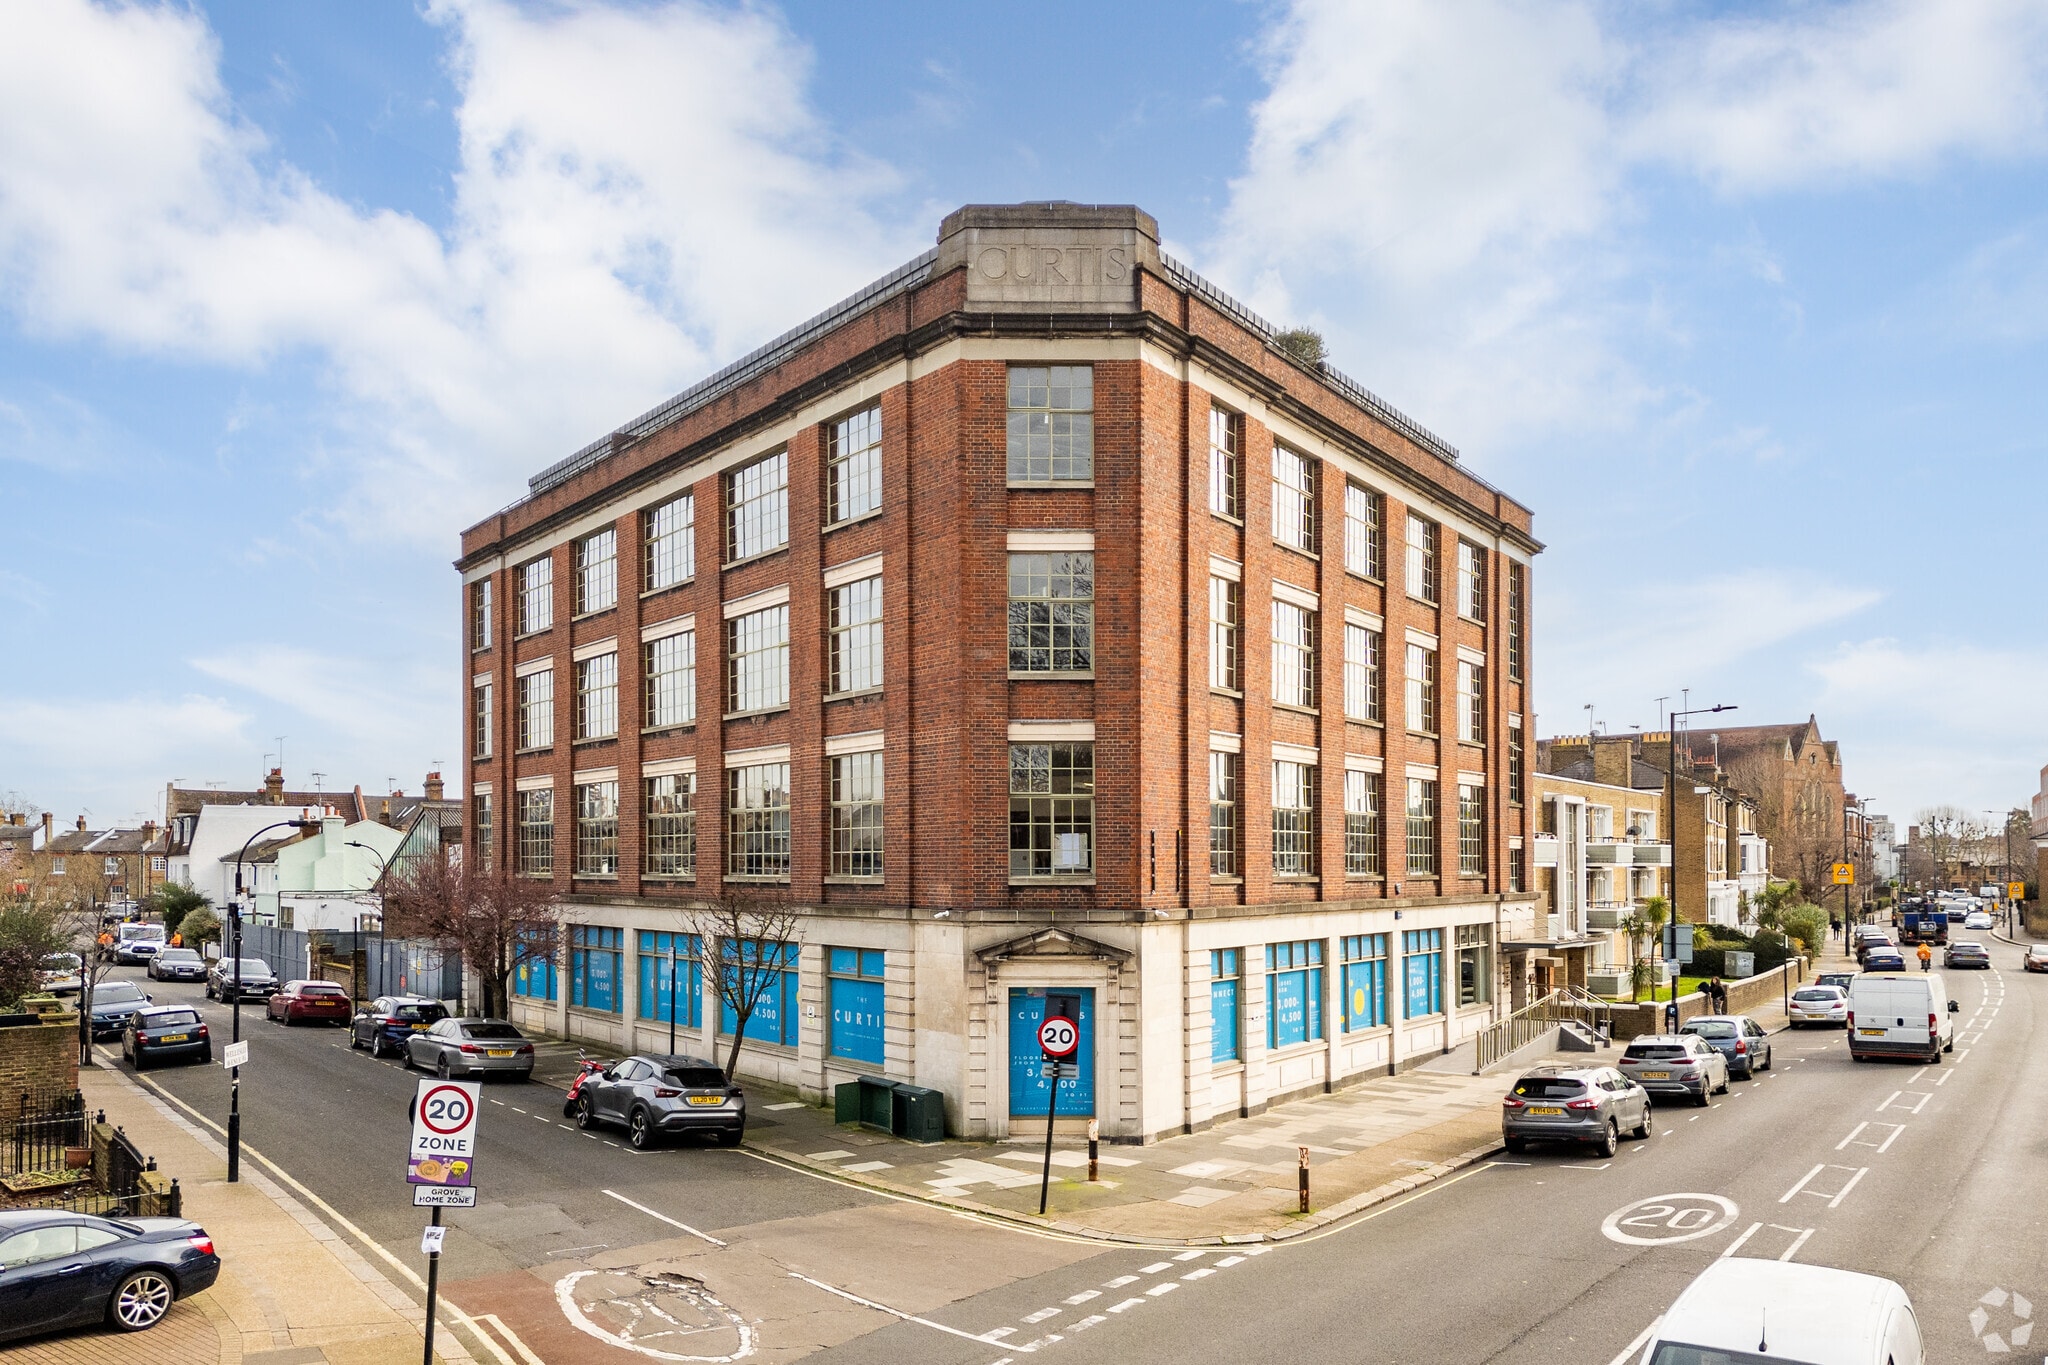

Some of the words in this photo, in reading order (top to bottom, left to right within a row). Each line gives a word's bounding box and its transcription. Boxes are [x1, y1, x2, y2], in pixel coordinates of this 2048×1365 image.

[976, 247, 1127, 283] CURTIS
[755, 1007, 777, 1020] 4,500
[1018, 1011, 1086, 1020] CUS
[1281, 1010, 1302, 1024] 4,500
[1044, 1027, 1073, 1045] 20
[1037, 1080, 1077, 1090] 4,00
[428, 1098, 465, 1121] 20
[418, 1136, 467, 1151] ZONE
[431, 1188, 460, 1196] GROVE
[446, 1196, 470, 1204] ZONE
[1620, 1205, 1716, 1229] 20
